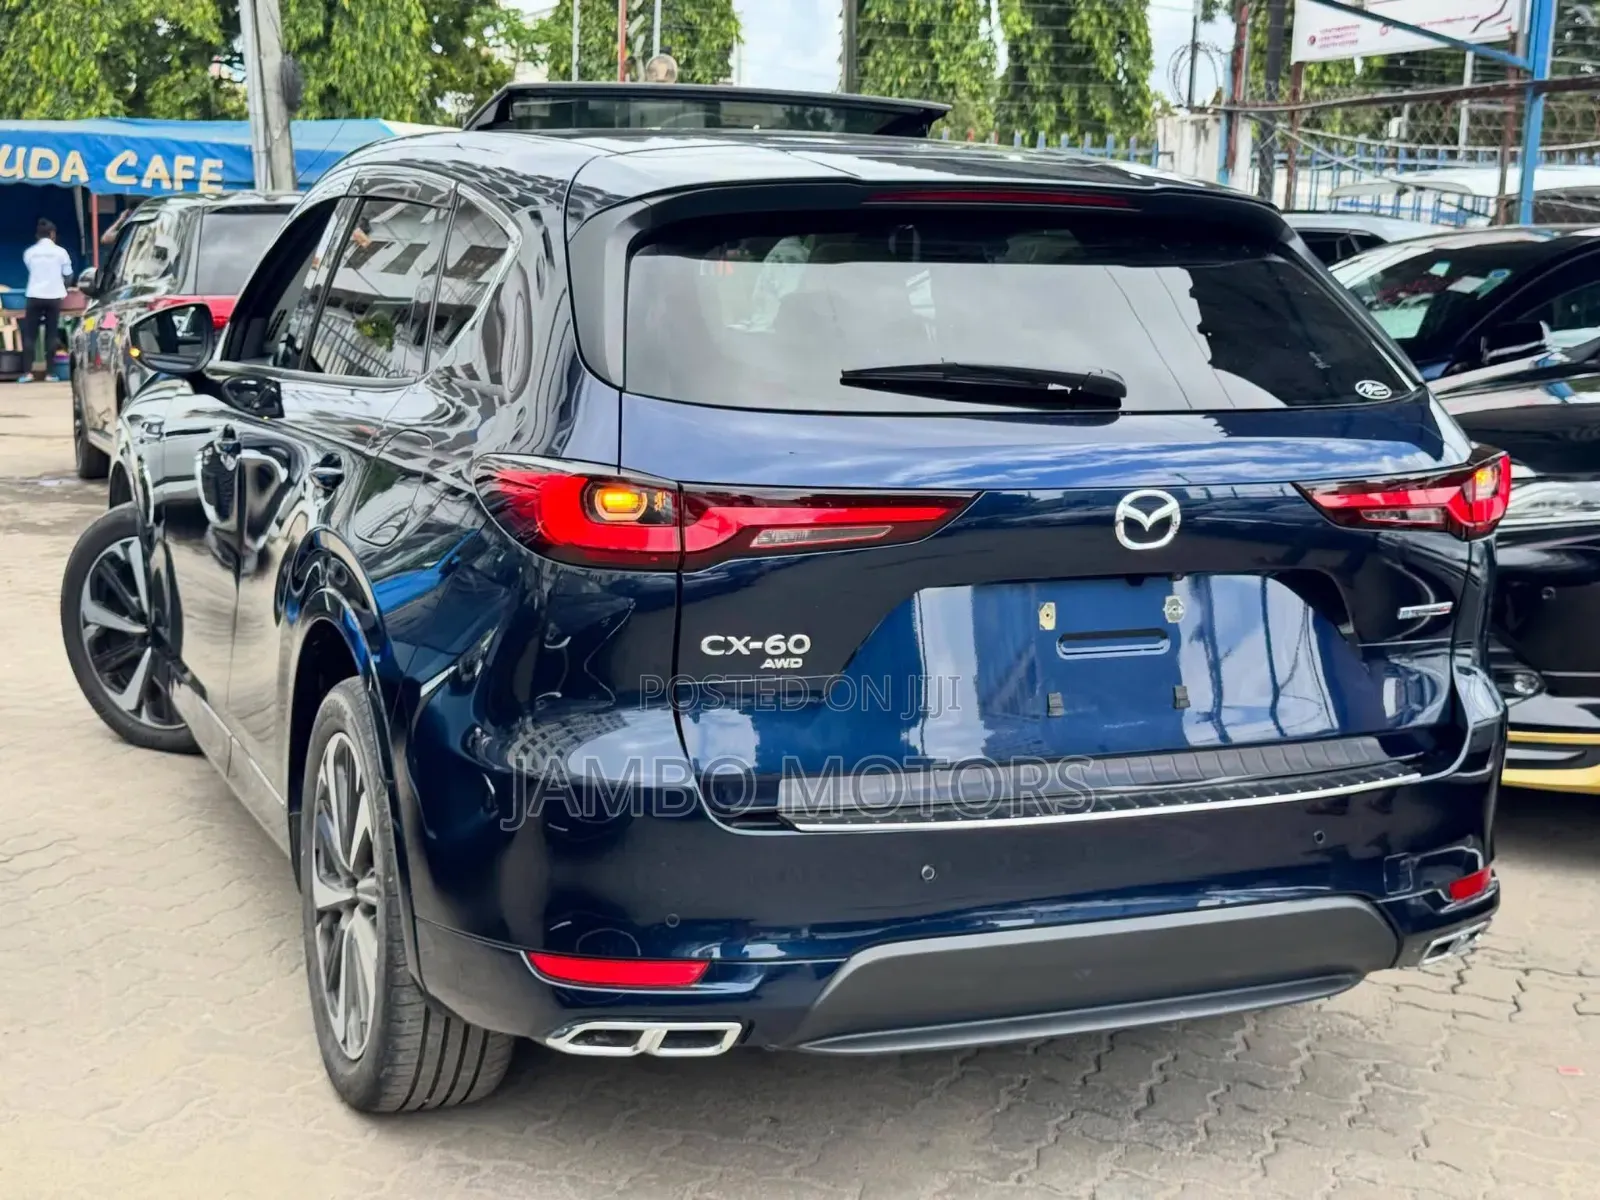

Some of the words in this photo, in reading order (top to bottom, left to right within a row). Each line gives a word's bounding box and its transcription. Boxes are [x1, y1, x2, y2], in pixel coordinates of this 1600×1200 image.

[105, 149, 224, 194] CAFE
[700, 633, 811, 656] CX-60
[760, 658, 803, 669] AWD
